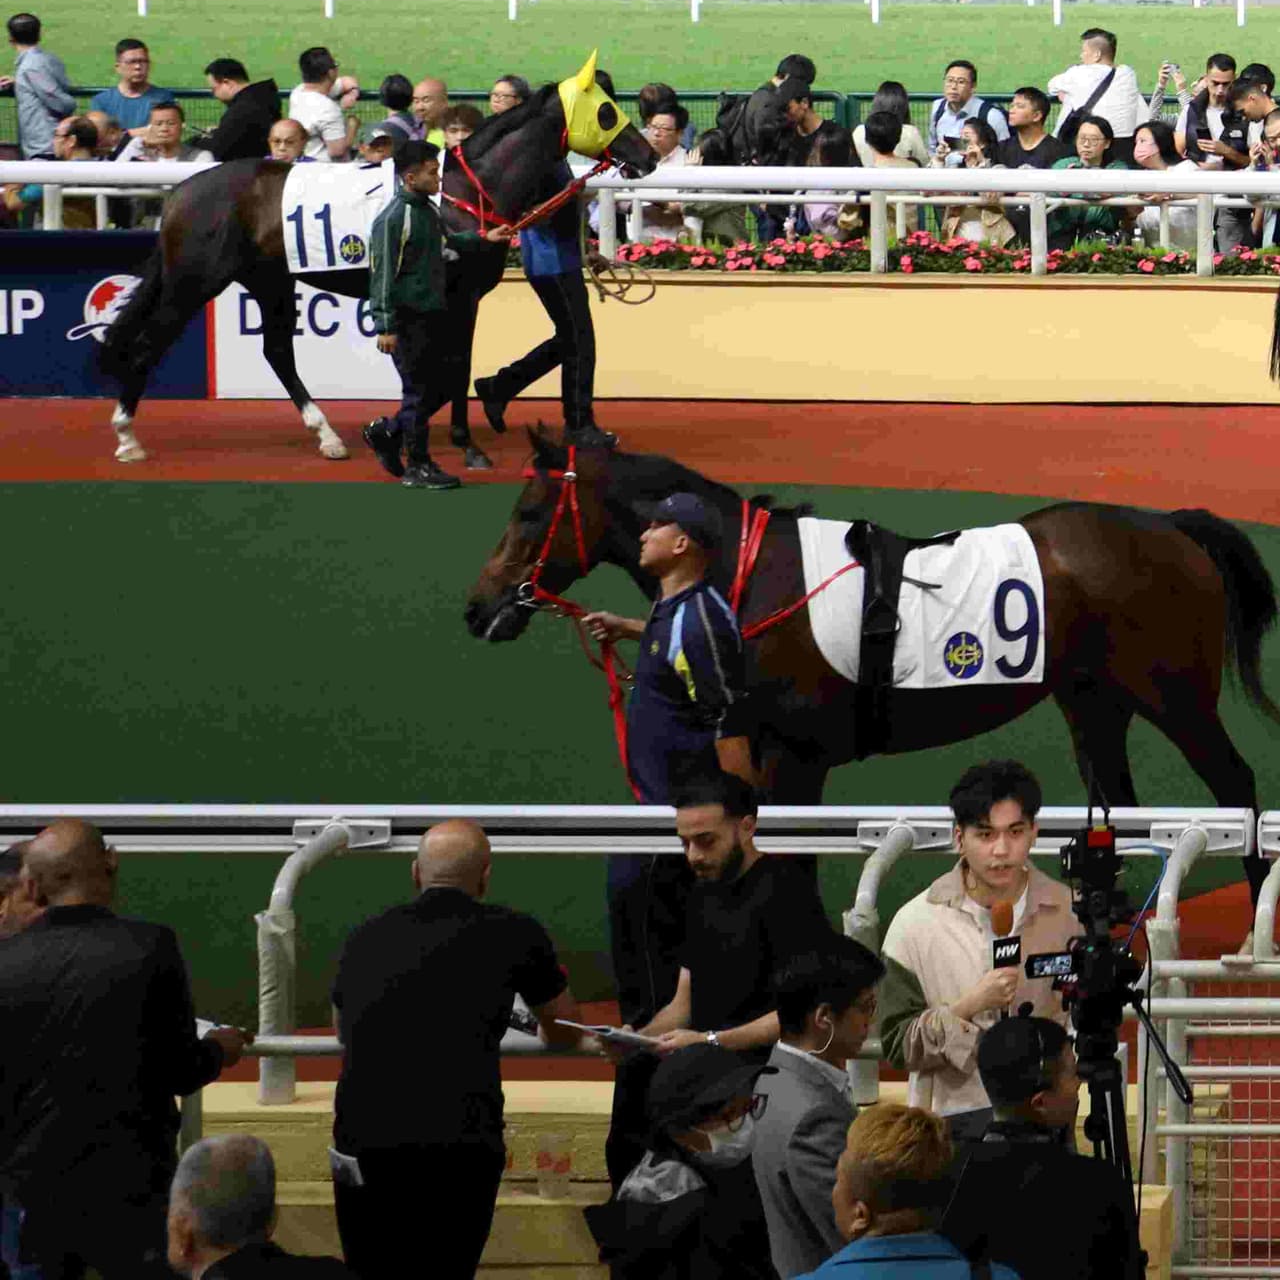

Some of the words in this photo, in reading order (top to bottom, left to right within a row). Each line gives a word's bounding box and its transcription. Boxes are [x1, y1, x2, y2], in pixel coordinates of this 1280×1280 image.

[287, 203, 336, 268] 11
[994, 578, 1040, 679] 9
[995, 943, 1019, 960] HW
